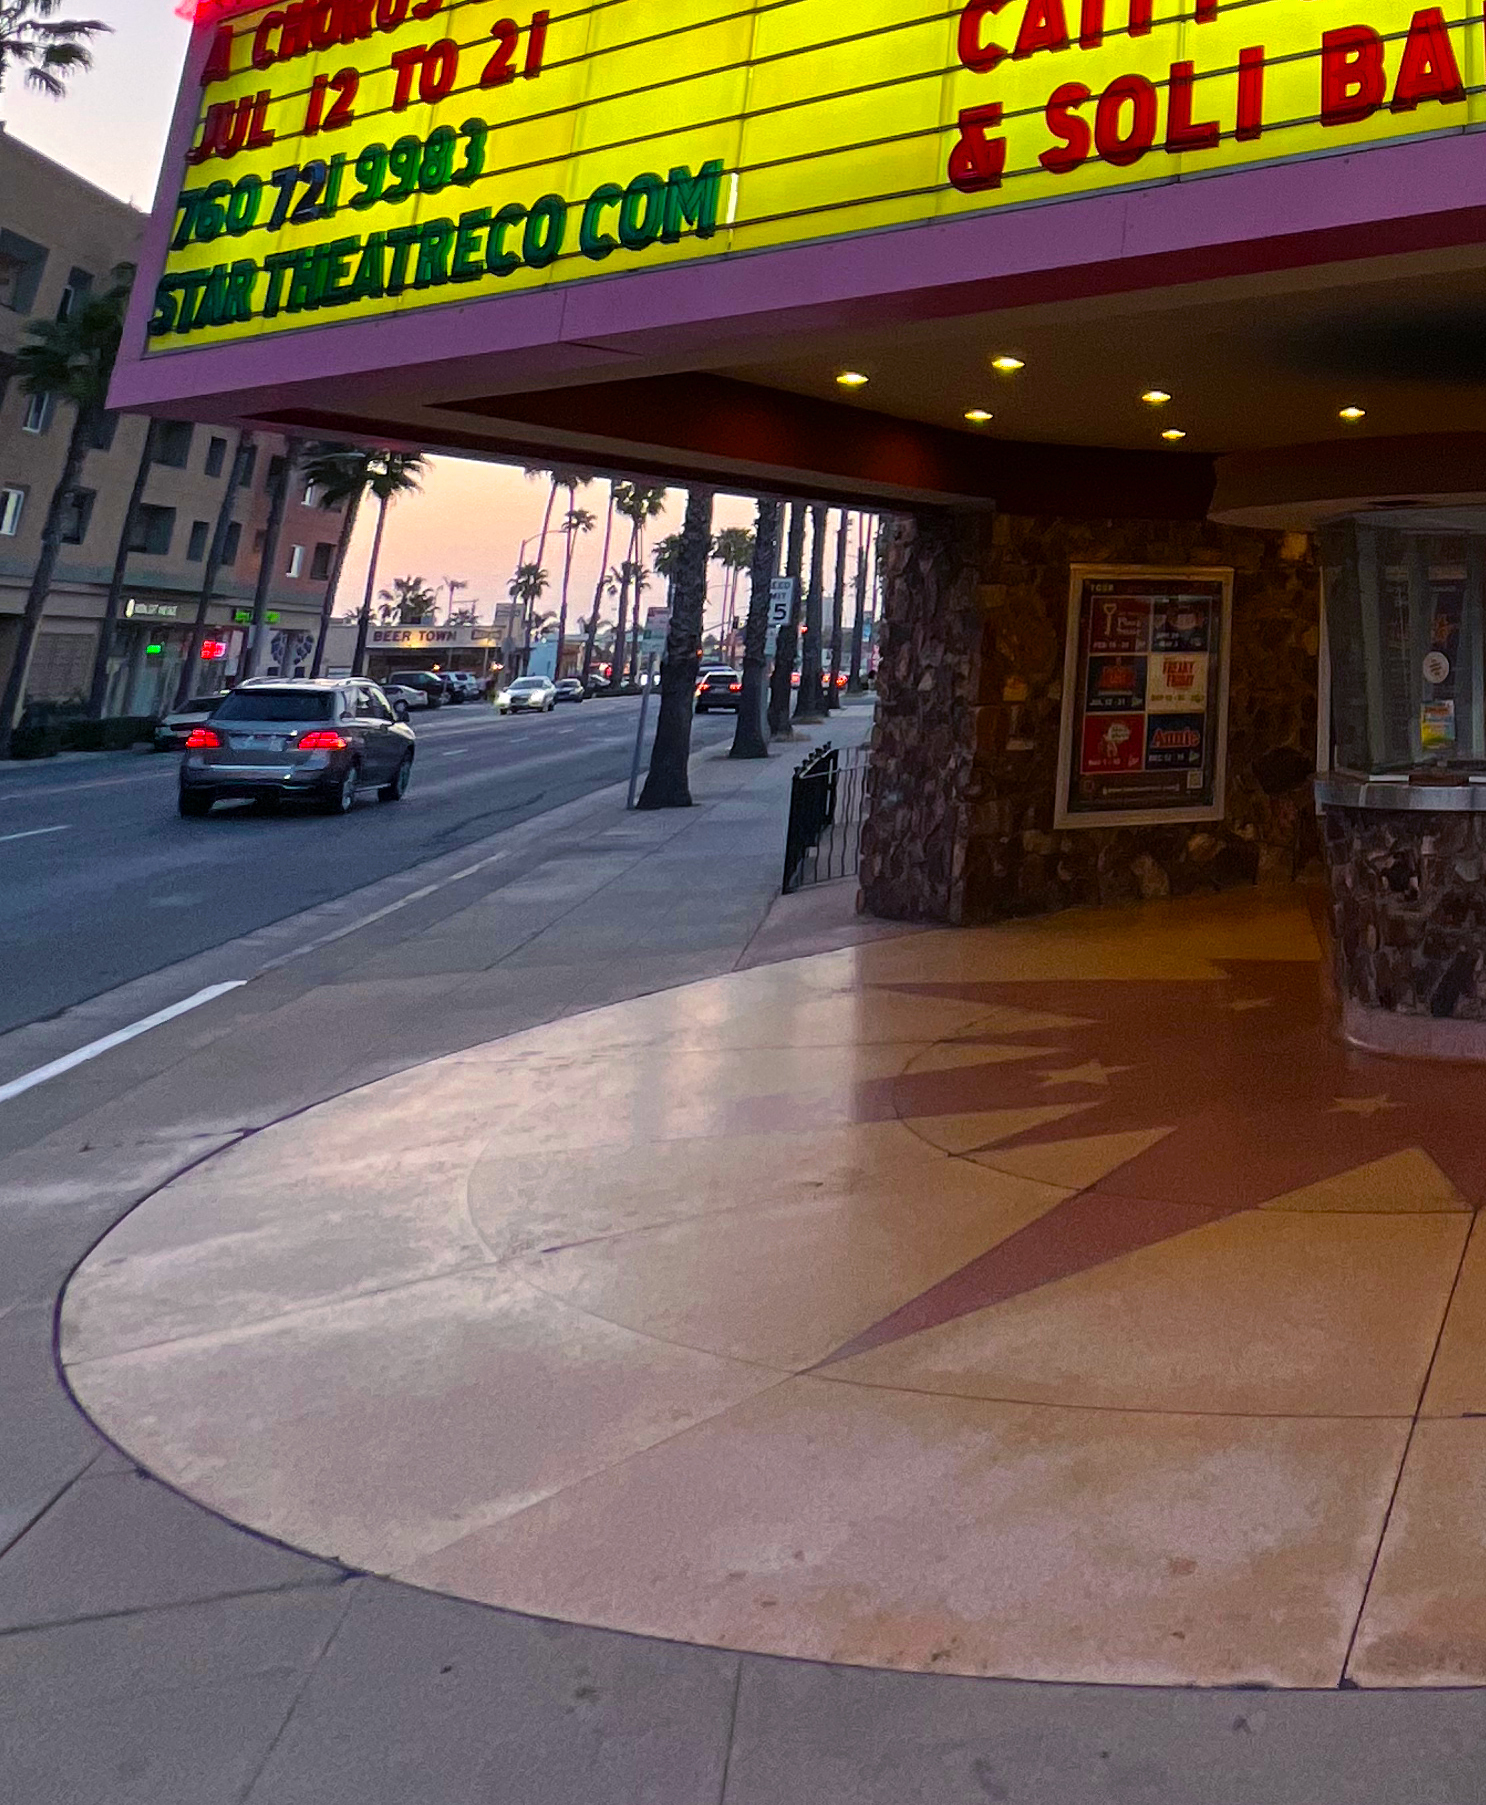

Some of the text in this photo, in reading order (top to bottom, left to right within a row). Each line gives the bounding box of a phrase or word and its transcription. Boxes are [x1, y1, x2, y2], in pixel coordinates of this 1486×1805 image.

[185, 10, 550, 165] JUL 12 TO 21
[202, 24, 232, 86] A
[948, 102, 1007, 193] &
[1038, 45, 1264, 174] SOLI
[171, 174, 263, 251] 760
[349, 117, 489, 212] 9983
[579, 159, 725, 261] COM
[372, 630, 457, 642] BEER TOWN
